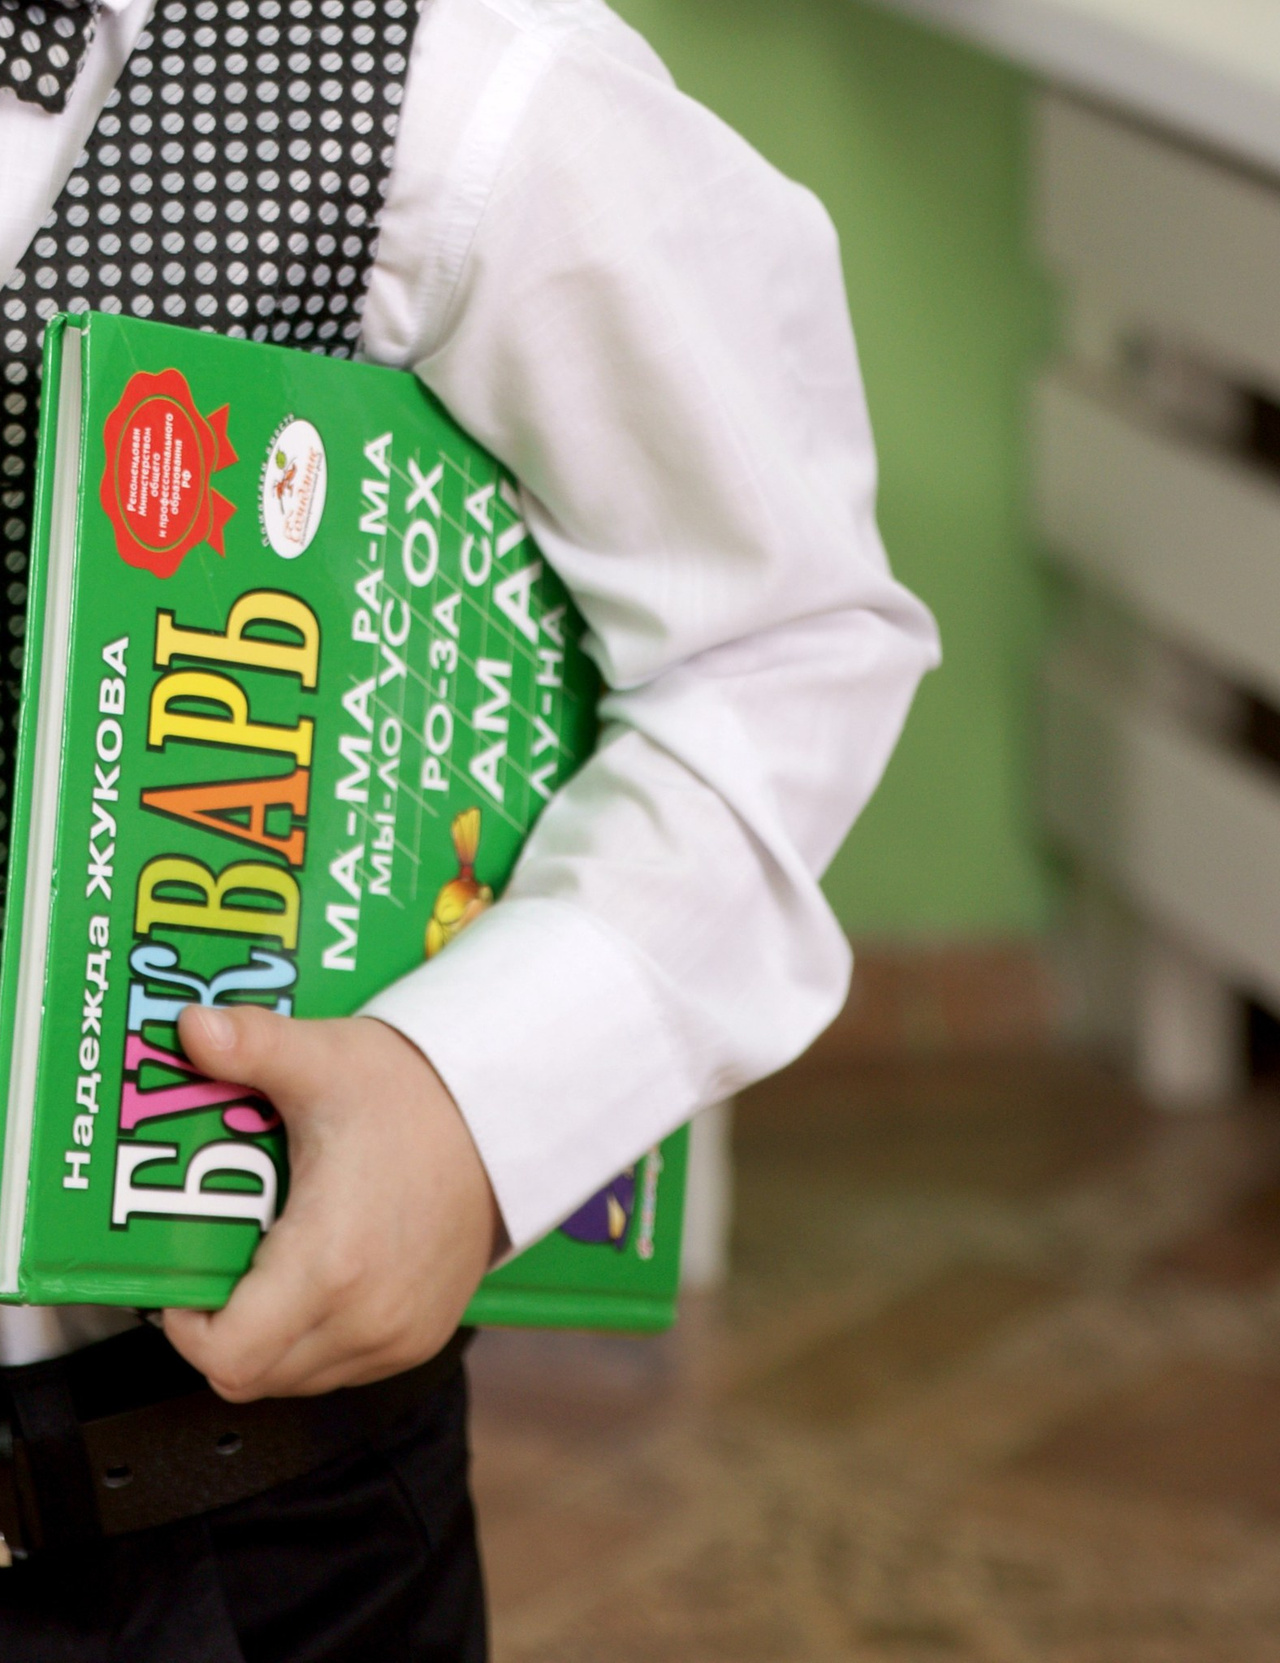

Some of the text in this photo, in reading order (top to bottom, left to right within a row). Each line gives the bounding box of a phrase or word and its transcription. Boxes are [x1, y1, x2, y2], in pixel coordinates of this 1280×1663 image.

[126, 427, 141, 512] Рекомендован
[138, 426, 151, 517] Министерством
[149, 452, 161, 497] общего
[159, 413, 174, 528] профессионального
[170, 439, 183, 515] образования
[182, 469, 192, 488] РФ
[403, 457, 443, 587] ОХ
[462, 485, 494, 587] СА
[322, 432, 392, 971] МА-МА РА-МА
[370, 596, 411, 896] МЫ-ЛО УС
[422, 593, 461, 791] РО-ЗА
[469, 657, 512, 802] АМ
[531, 604, 566, 800] ЛУ-НА
[63, 636, 130, 1190] Надежда ЖУКОВА
[109, 588, 320, 1233] БУКВАРЬ
